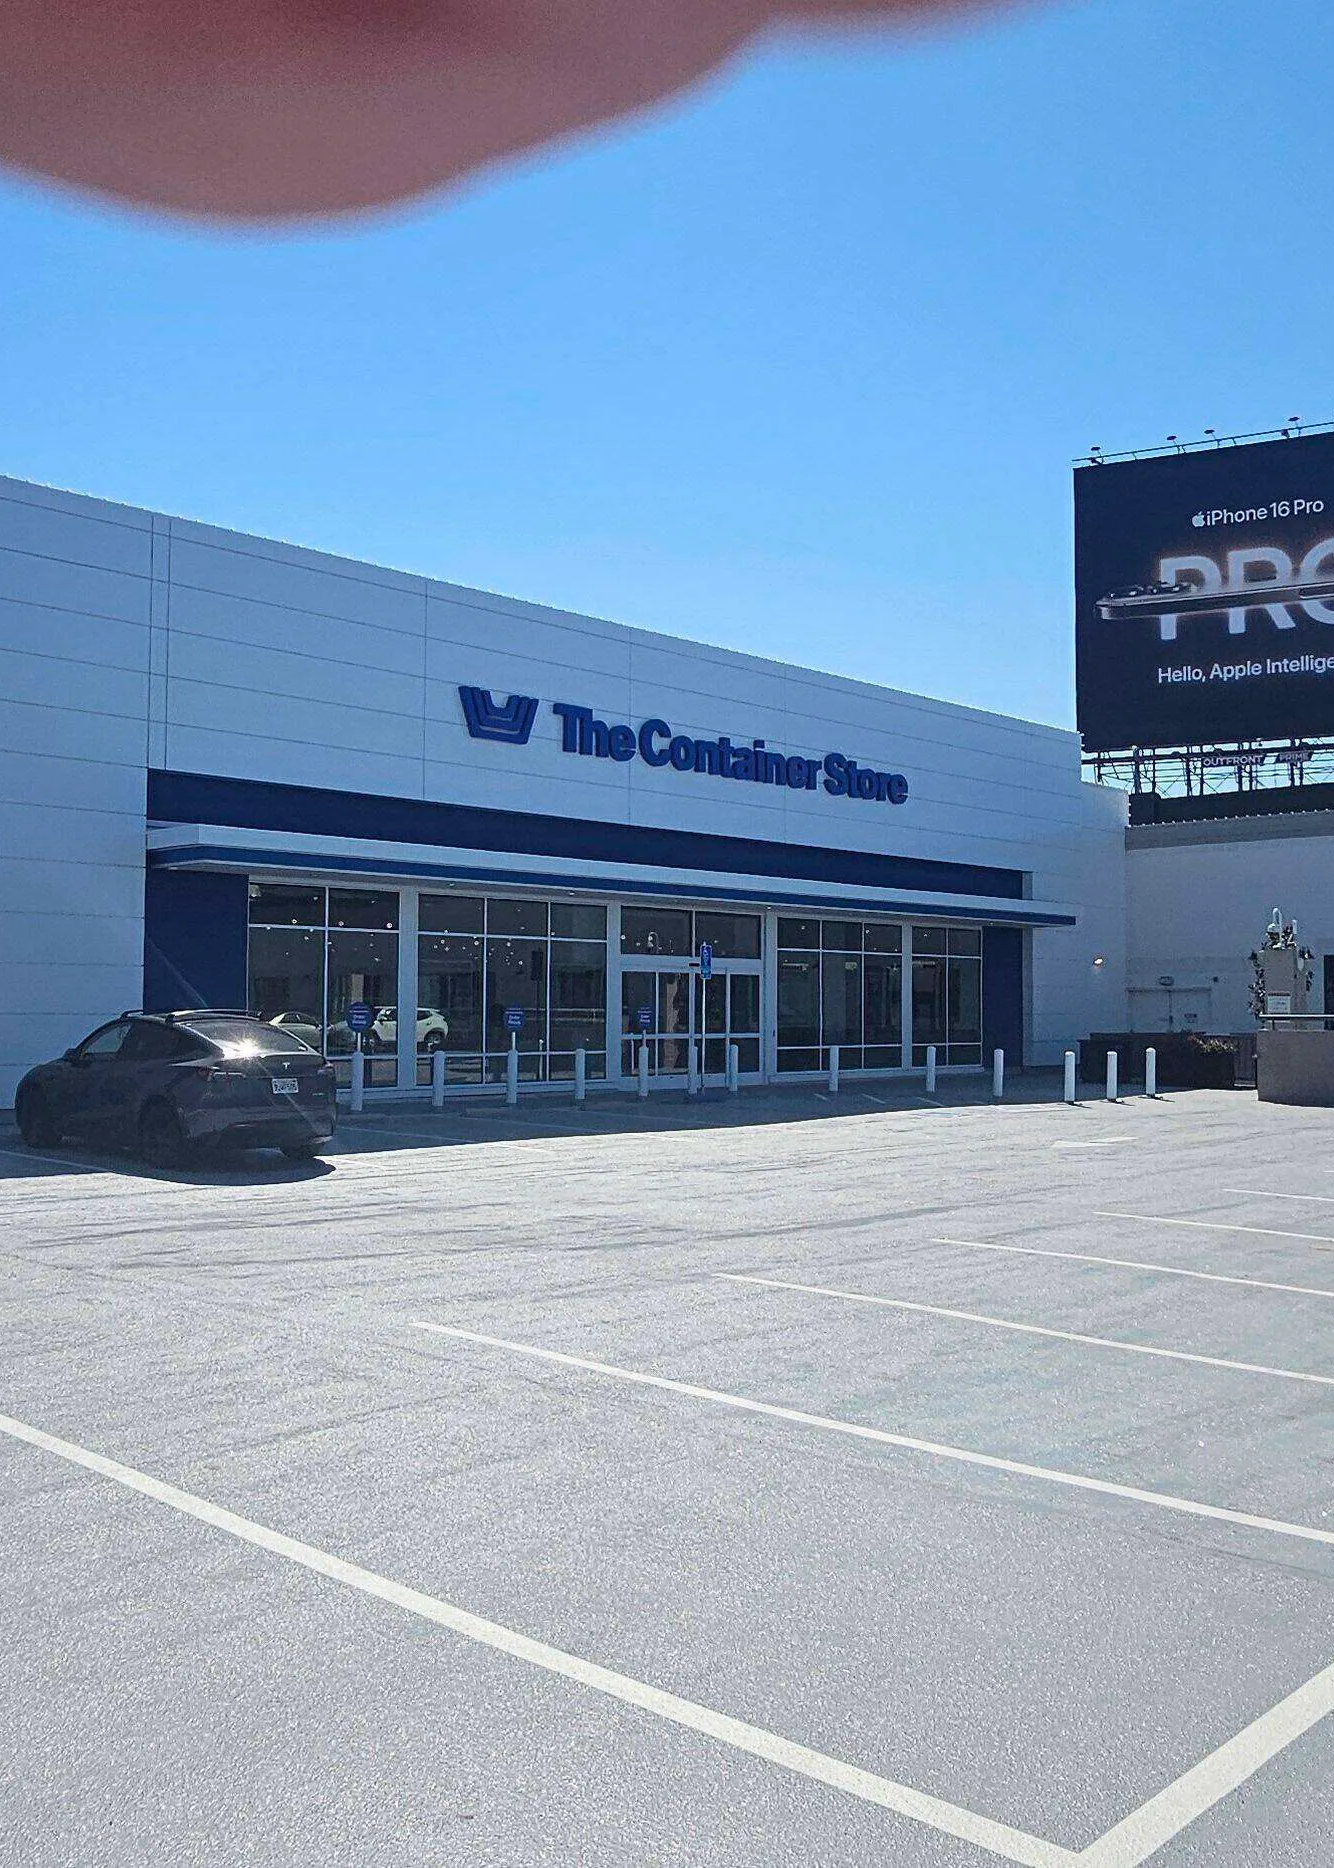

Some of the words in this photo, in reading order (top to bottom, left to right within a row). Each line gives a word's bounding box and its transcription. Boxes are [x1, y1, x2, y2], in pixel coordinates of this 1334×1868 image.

[1206, 507, 1268, 527] iPhone
[1270, 501, 1290, 519] 16
[1294, 499, 1324, 515] Pro
[1157, 666, 1206, 685] Hello,
[1210, 660, 1262, 681] Apple
[553, 702, 636, 762] The
[638, 718, 822, 790] Container
[823, 752, 908, 804] Store
[1202, 754, 1264, 767] OUTFRONT
